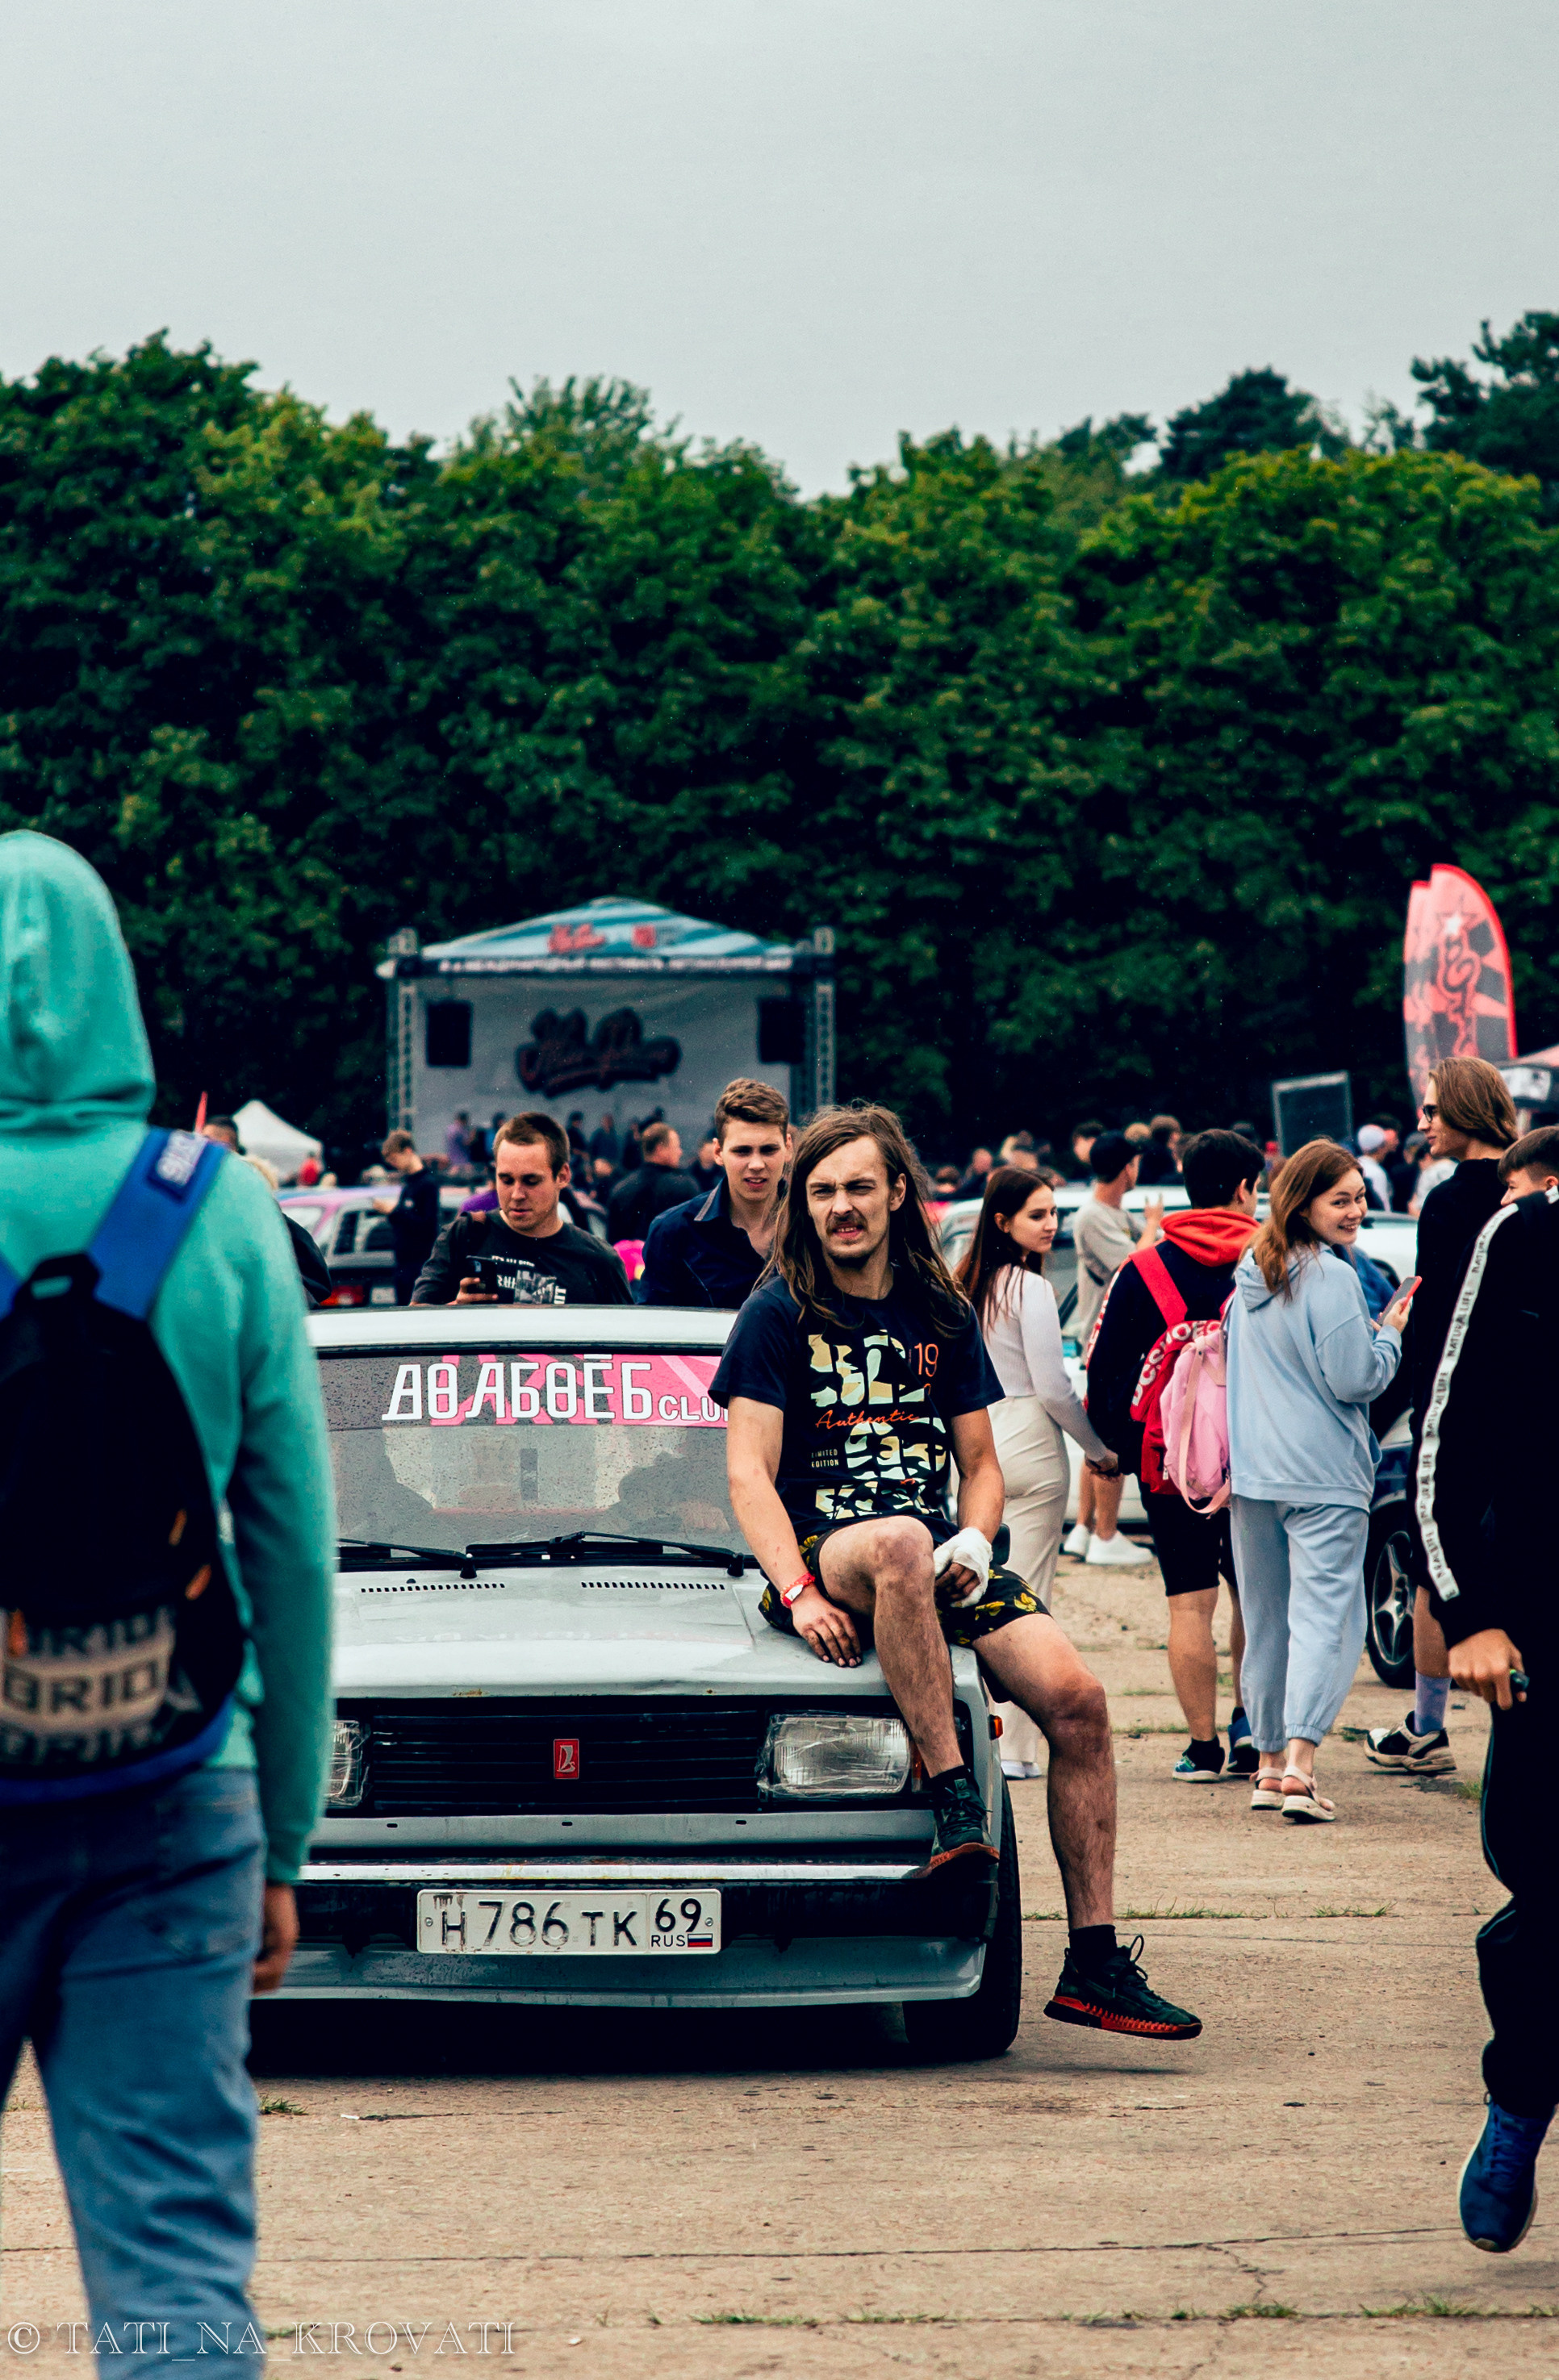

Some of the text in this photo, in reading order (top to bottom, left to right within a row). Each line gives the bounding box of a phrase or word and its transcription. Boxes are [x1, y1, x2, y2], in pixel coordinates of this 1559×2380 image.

[913, 1342, 939, 1378] 19
[658, 1395, 729, 1422] CLU
[815, 1409, 920, 1430] Authentic
[810, 1459, 840, 1468] EDITION
[655, 1898, 701, 1933] 69
[651, 1935, 685, 1948] RUS
